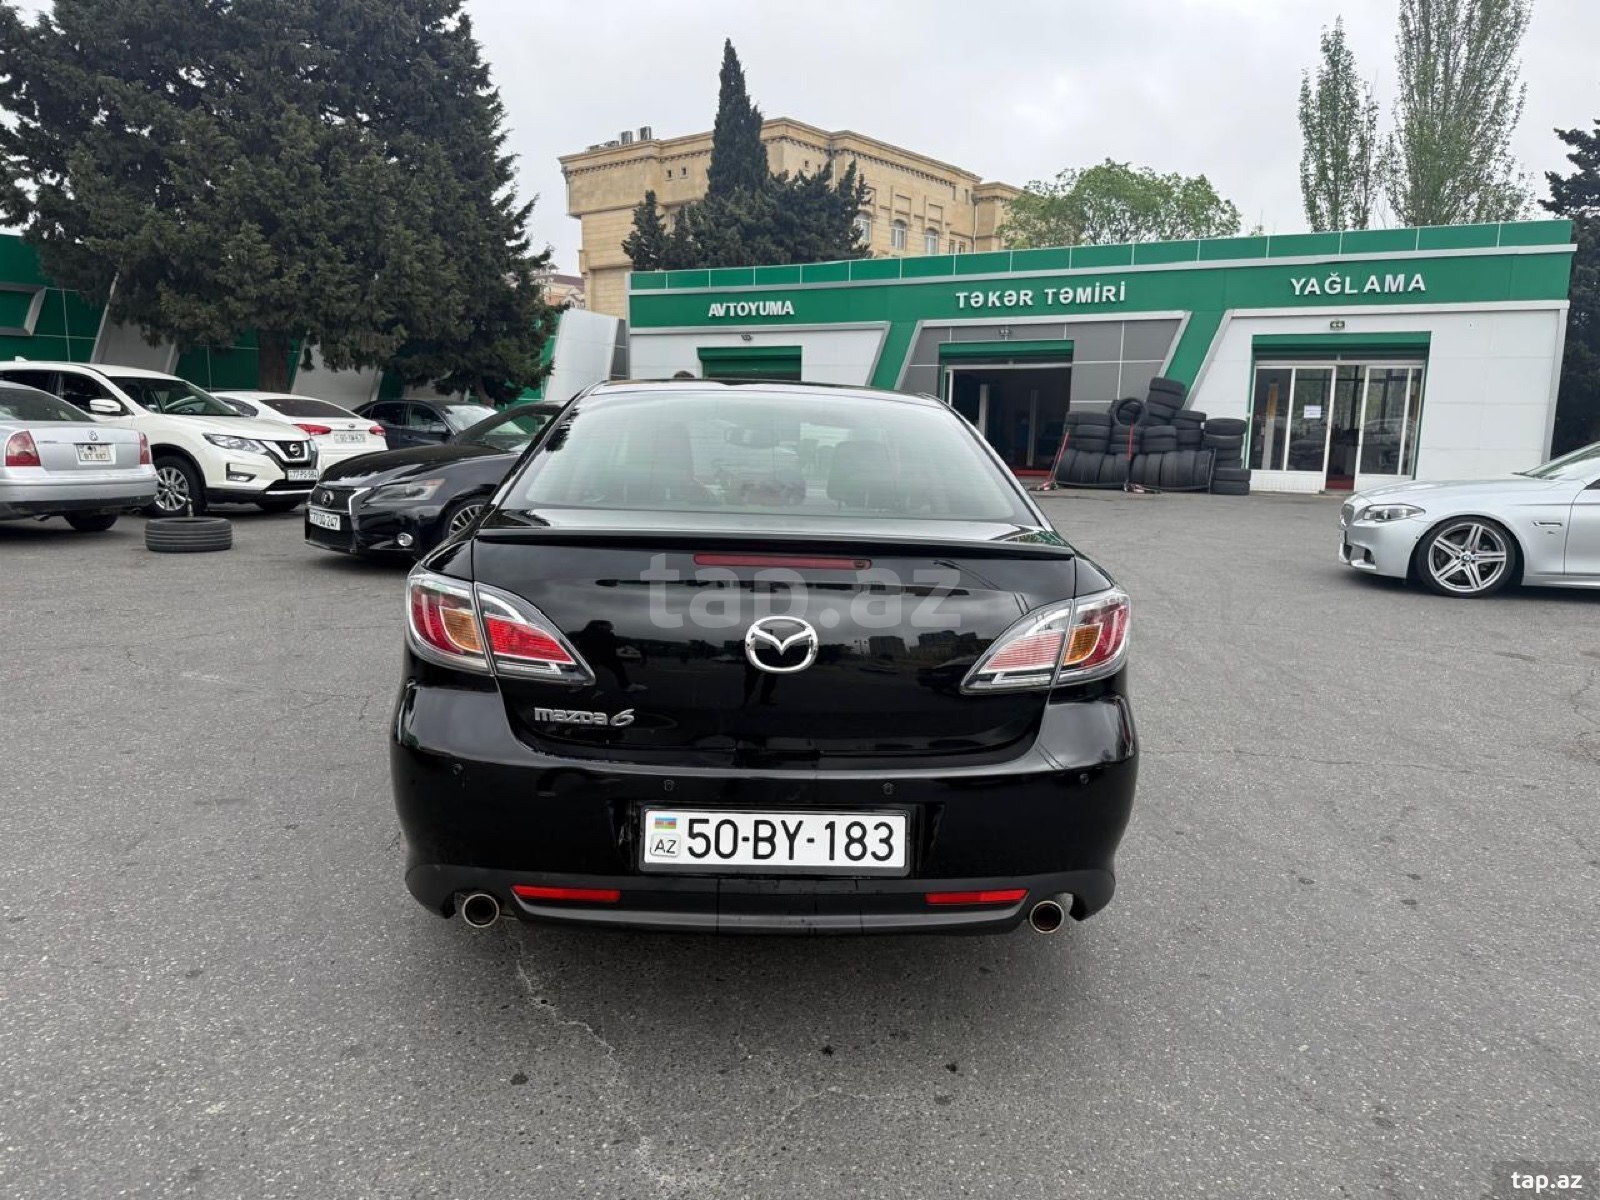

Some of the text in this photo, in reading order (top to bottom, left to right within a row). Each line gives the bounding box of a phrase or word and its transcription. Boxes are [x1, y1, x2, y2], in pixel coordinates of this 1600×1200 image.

[955, 280, 1126, 309] TƏKƏR TƏMİRİ
[1290, 271, 1426, 296] YAĞLAMA
[708, 300, 795, 317] AVTOYUMA
[609, 708, 635, 727] 6
[653, 838, 677, 855] AZ
[687, 818, 894, 862] 50-BY-183
